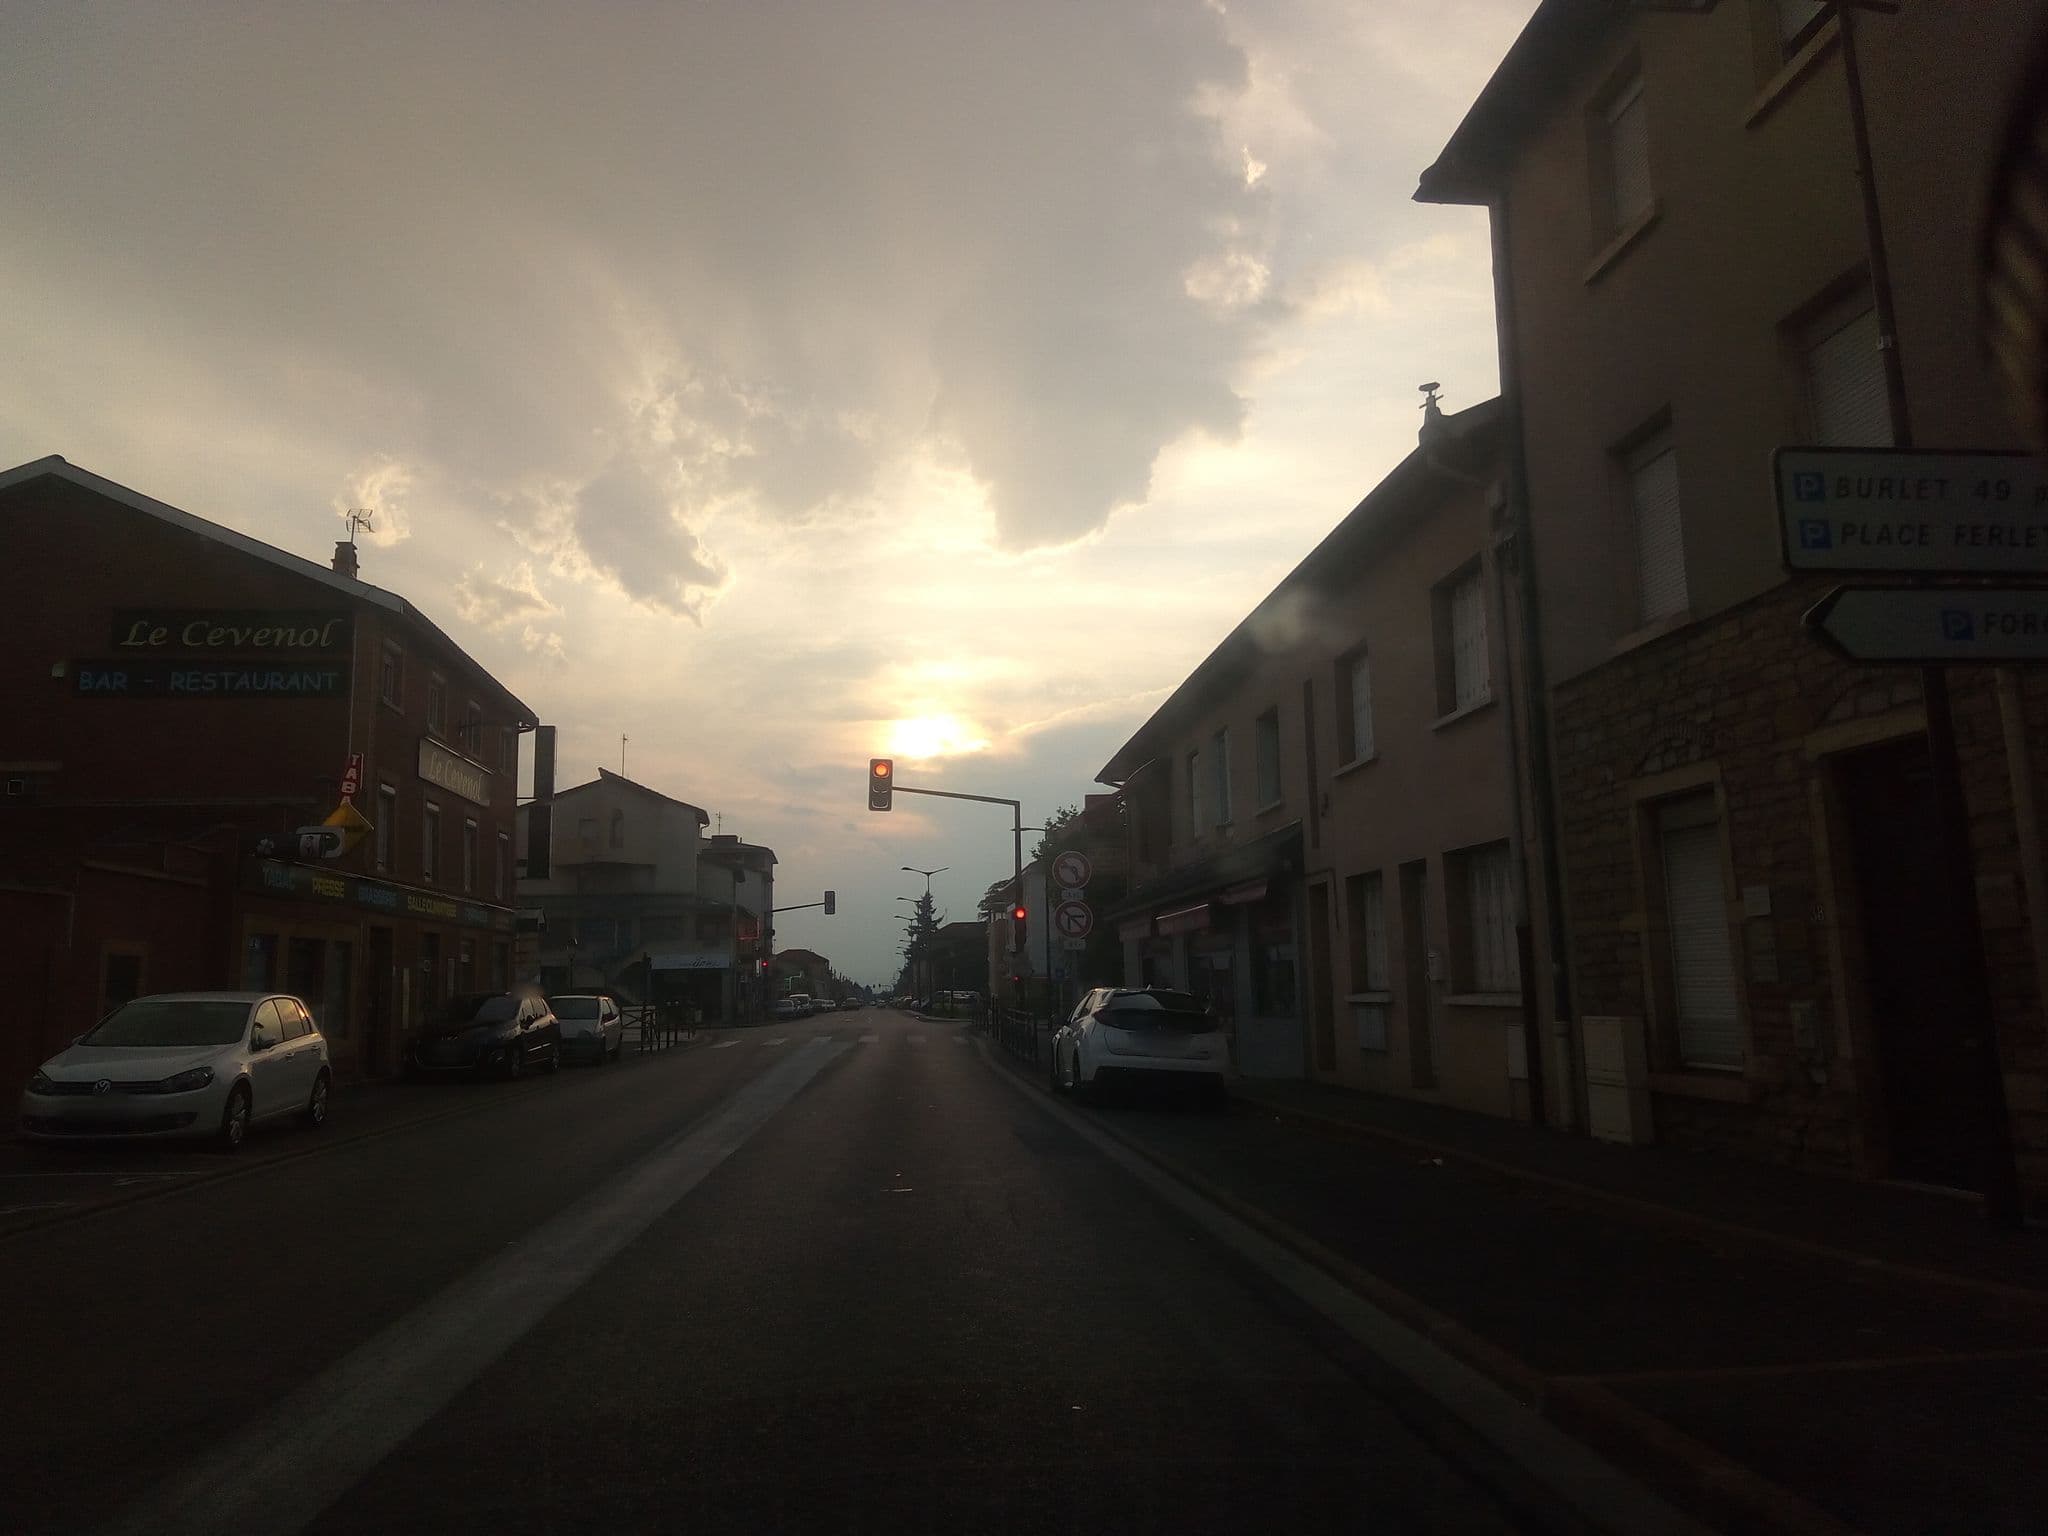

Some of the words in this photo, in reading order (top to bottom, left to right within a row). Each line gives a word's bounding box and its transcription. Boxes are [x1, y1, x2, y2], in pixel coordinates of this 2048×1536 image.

[1836, 477, 1949, 501] BURLET
[1972, 479, 2010, 502] 49
[1841, 522, 1930, 546] PLACE
[119, 619, 168, 647] Le
[181, 617, 344, 648] Cevenol
[79, 671, 129, 691] BAR
[169, 671, 340, 692] RESTAURANT
[312, 877, 345, 898] PRESSE
